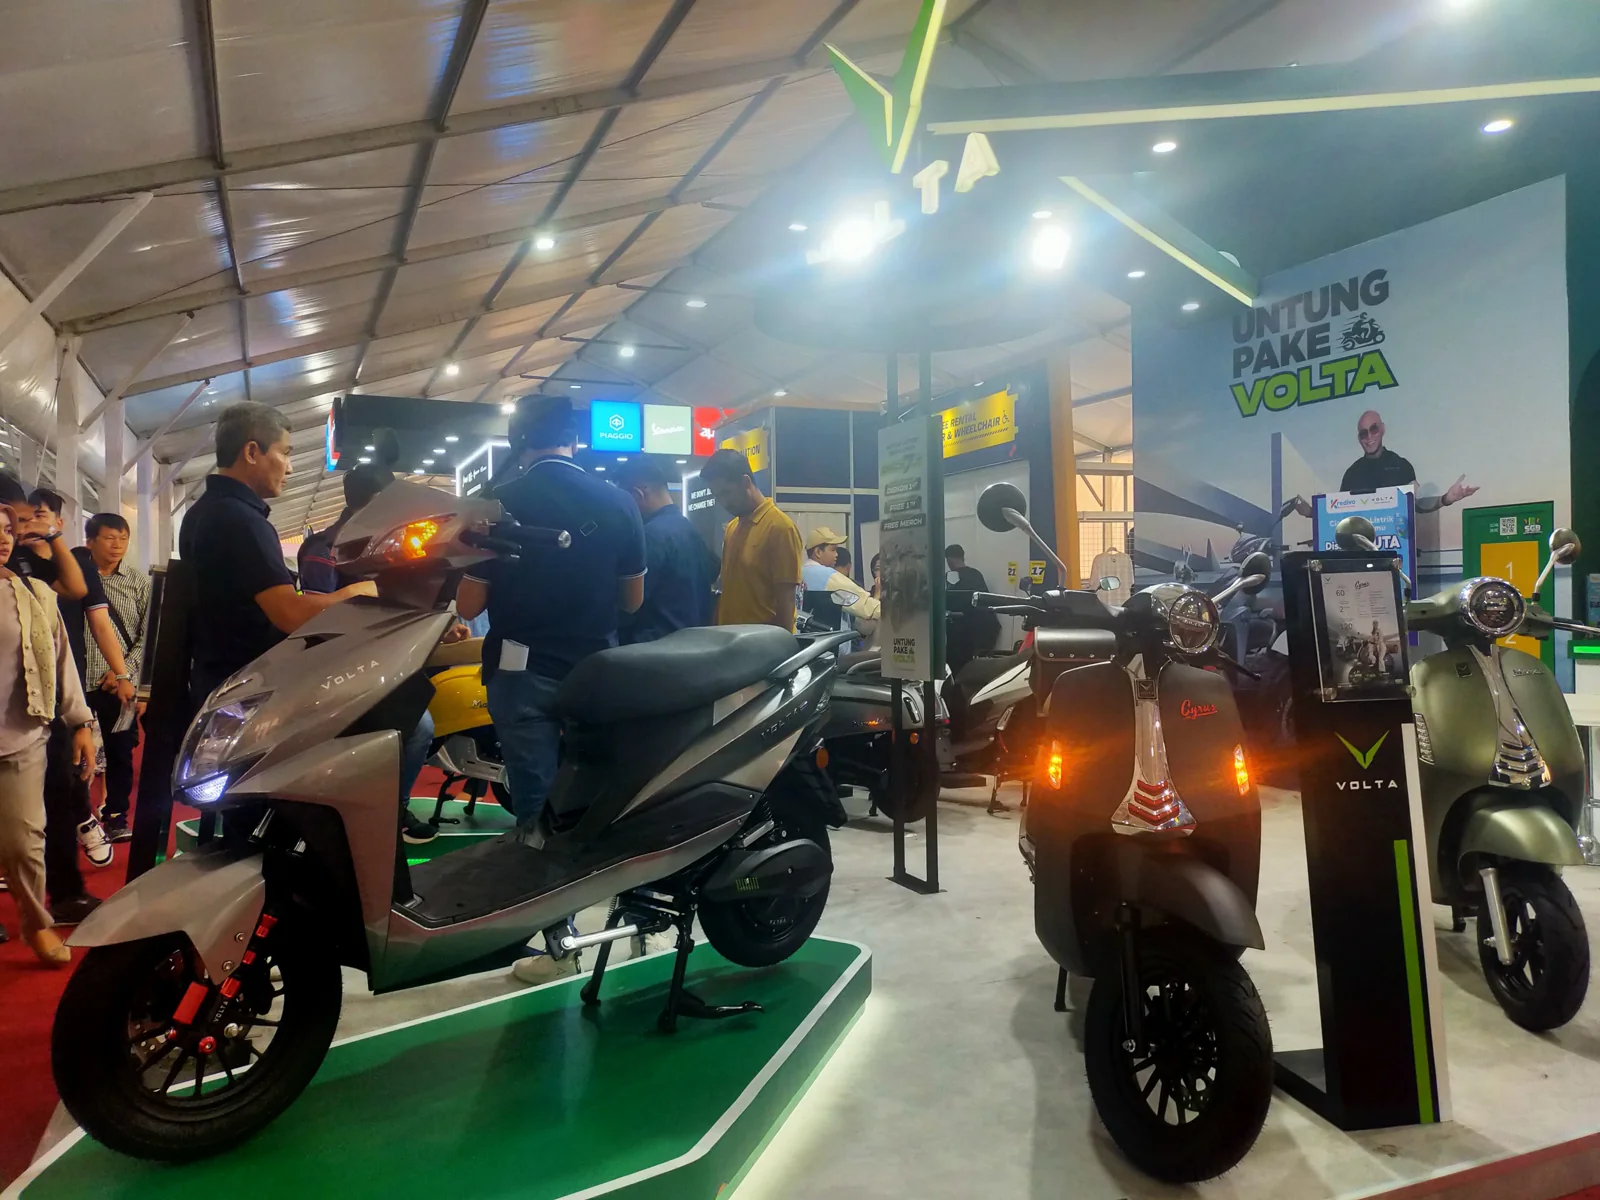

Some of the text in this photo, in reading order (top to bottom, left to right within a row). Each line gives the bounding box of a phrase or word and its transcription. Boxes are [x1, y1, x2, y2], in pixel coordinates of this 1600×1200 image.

[1232, 269, 1389, 344] UNTUNG
[1233, 322, 1331, 379] PAKE
[1229, 349, 1399, 418] VOLTA
[950, 412, 977, 427] RENTAL
[947, 430, 953, 440] &
[954, 416, 1001, 438] WHEELCHAIR
[600, 432, 634, 440] PIAGGIO
[693, 500, 707, 510] CHANGE
[889, 502, 906, 511] FREE
[1330, 498, 1356, 508] Kredivo
[883, 517, 923, 530] FREE MERCH
[1370, 515, 1394, 523] Listrik
[1008, 567, 1016, 576] 21
[1031, 567, 1045, 575] 17
[1505, 561, 1513, 580] 1
[1336, 589, 1345, 597] 60
[893, 638, 915, 647] UNTUNG
[893, 646, 908, 654] PAKE
[321, 660, 380, 690] VOLTA
[1181, 699, 1218, 720] Cyrus
[1336, 779, 1398, 791] VOLTA
[213, 1000, 229, 1023] VOLTA
